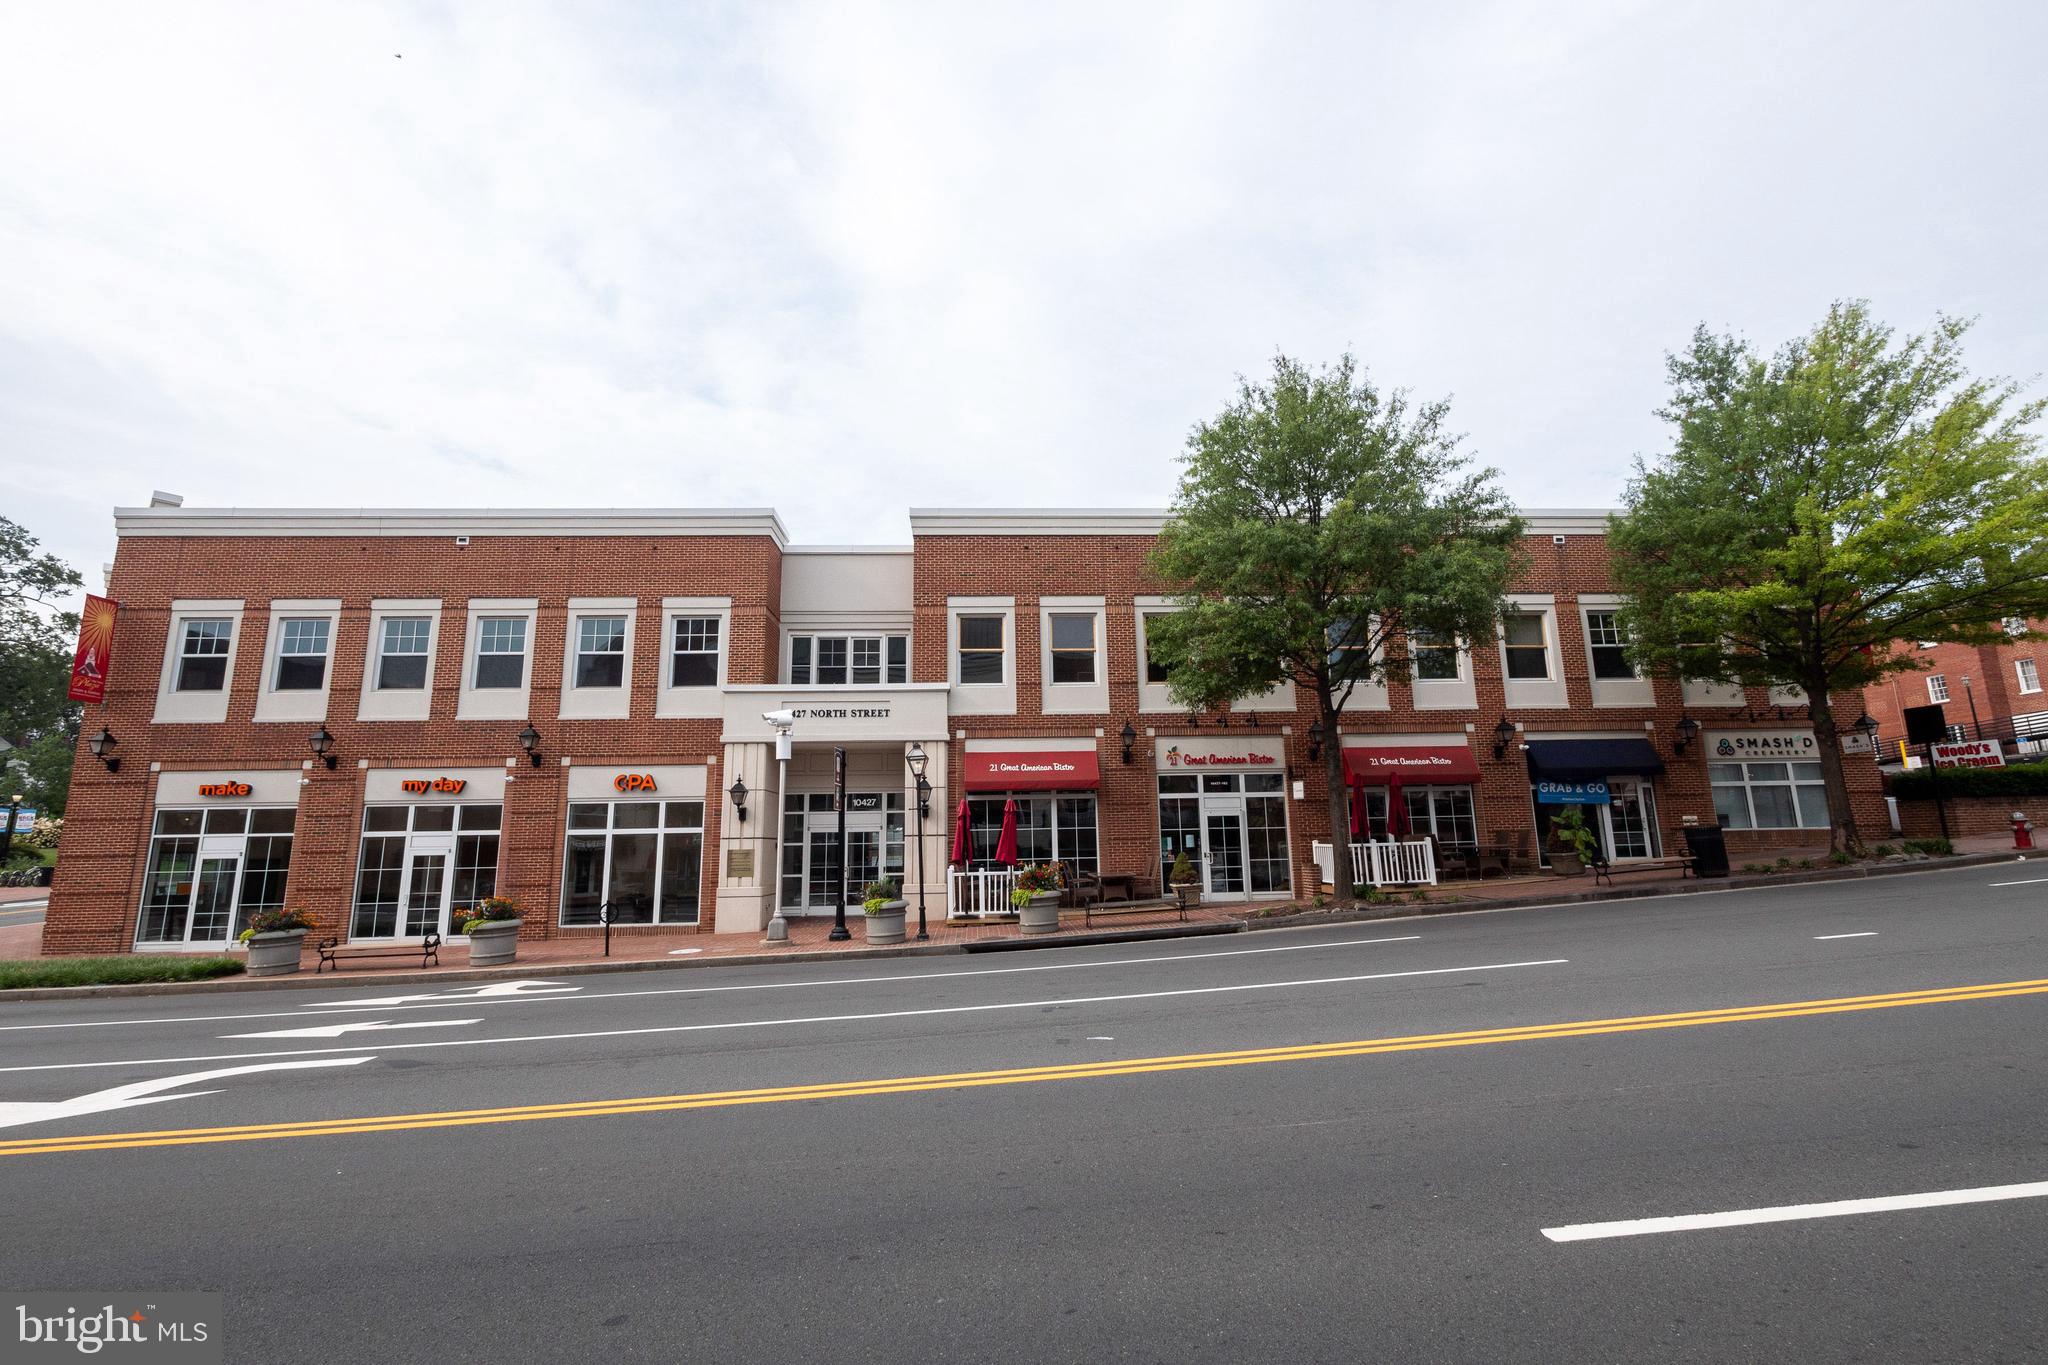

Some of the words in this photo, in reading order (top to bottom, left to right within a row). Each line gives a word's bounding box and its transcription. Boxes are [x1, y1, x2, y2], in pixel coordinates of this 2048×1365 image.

[810, 709, 847, 718] NORTH
[851, 709, 891, 718] STREET
[1936, 743, 1991, 758] Woody's
[1183, 754, 1207, 766] Great
[1208, 754, 1247, 765] American
[1248, 752, 1275, 764] Bistro
[1369, 758, 1379, 766] 21
[1380, 757, 1399, 765] Great
[1400, 757, 1431, 765] American
[1430, 756, 1452, 765] Bistro
[1957, 756, 2001, 768] Cream
[989, 763, 998, 771] 21
[1000, 763, 1019, 771] Great
[1020, 763, 1053, 771] American
[1053, 762, 1075, 771] Bistro
[199, 780, 253, 796] make
[401, 780, 431, 795] my
[431, 777, 467, 794] day
[613, 774, 658, 792] CPA
[1540, 782, 1573, 793] GRAB
[1575, 784, 1583, 793] &
[1586, 783, 1606, 793] GO
[852, 798, 877, 807] 10427
